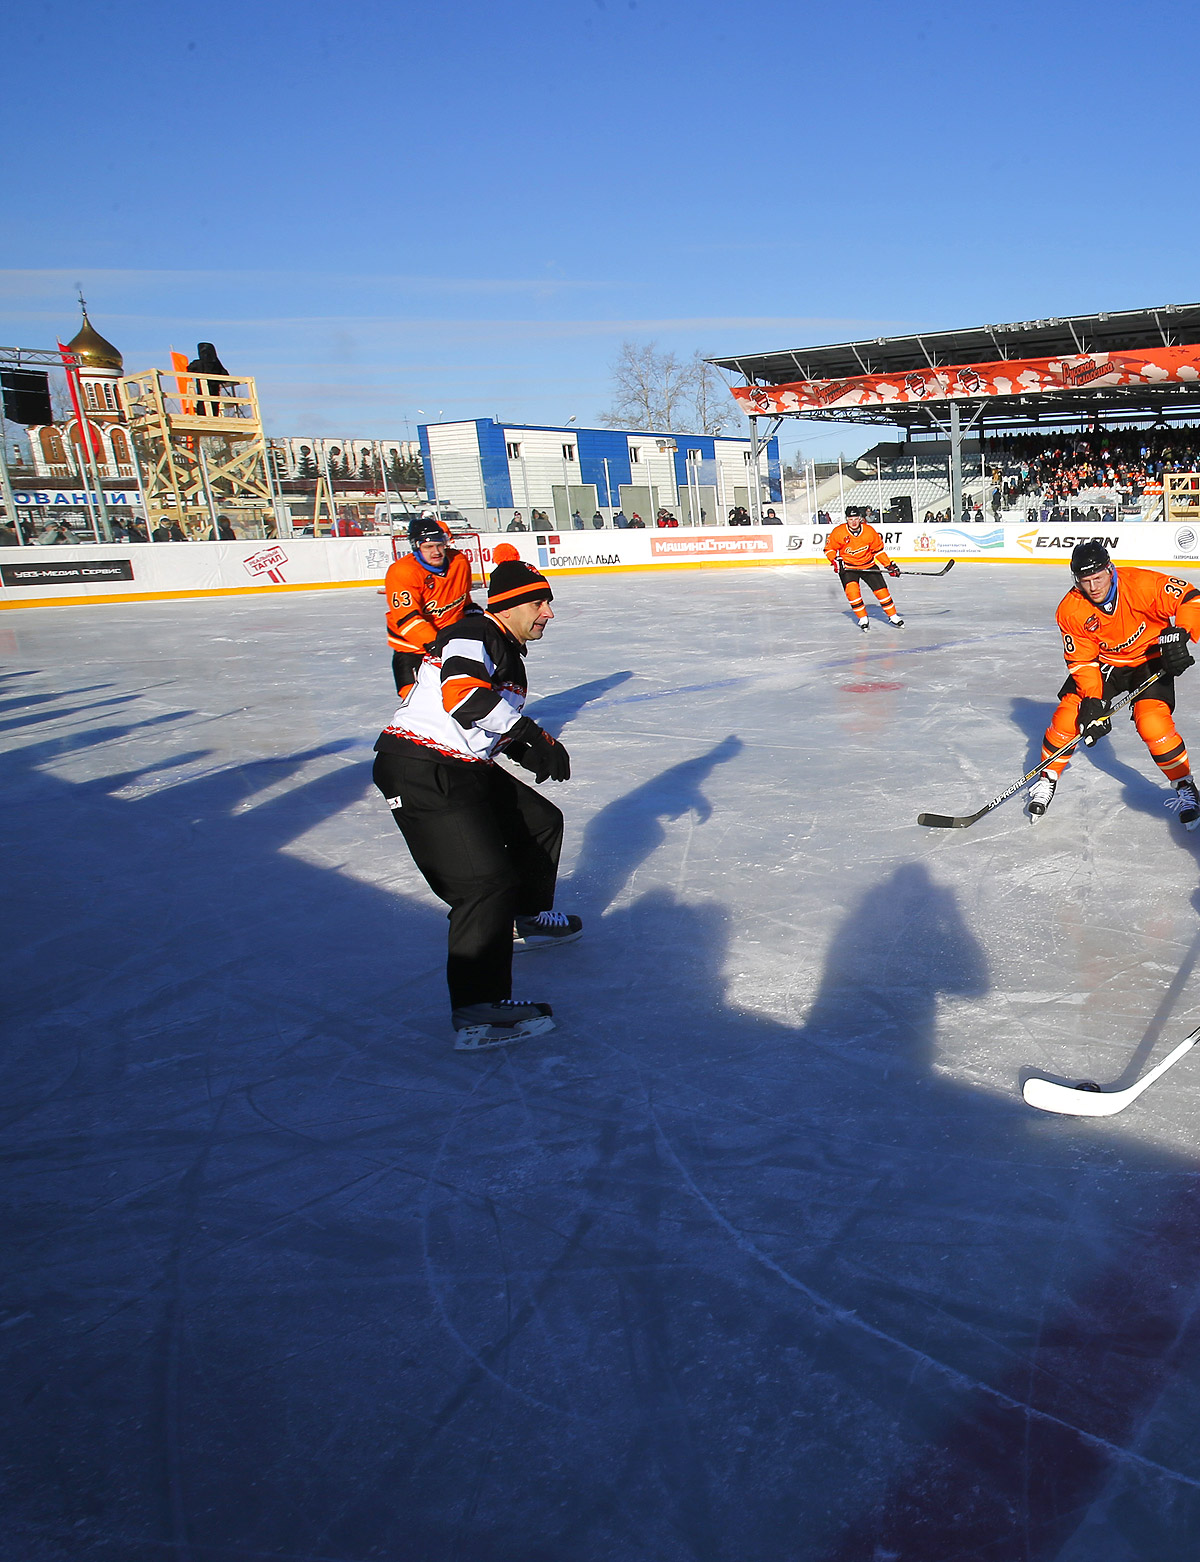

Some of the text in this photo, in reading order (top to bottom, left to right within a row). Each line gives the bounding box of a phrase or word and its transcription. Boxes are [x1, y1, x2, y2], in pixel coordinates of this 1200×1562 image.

[1062, 359, 1096, 385] Русская
[1077, 361, 1114, 386] классика
[252, 554, 282, 571] ТАГИЛ
[550, 554, 621, 567] ФОРМУЛА ЛЬДА
[1164, 575, 1188, 599] 38
[392, 591, 412, 609] 63
